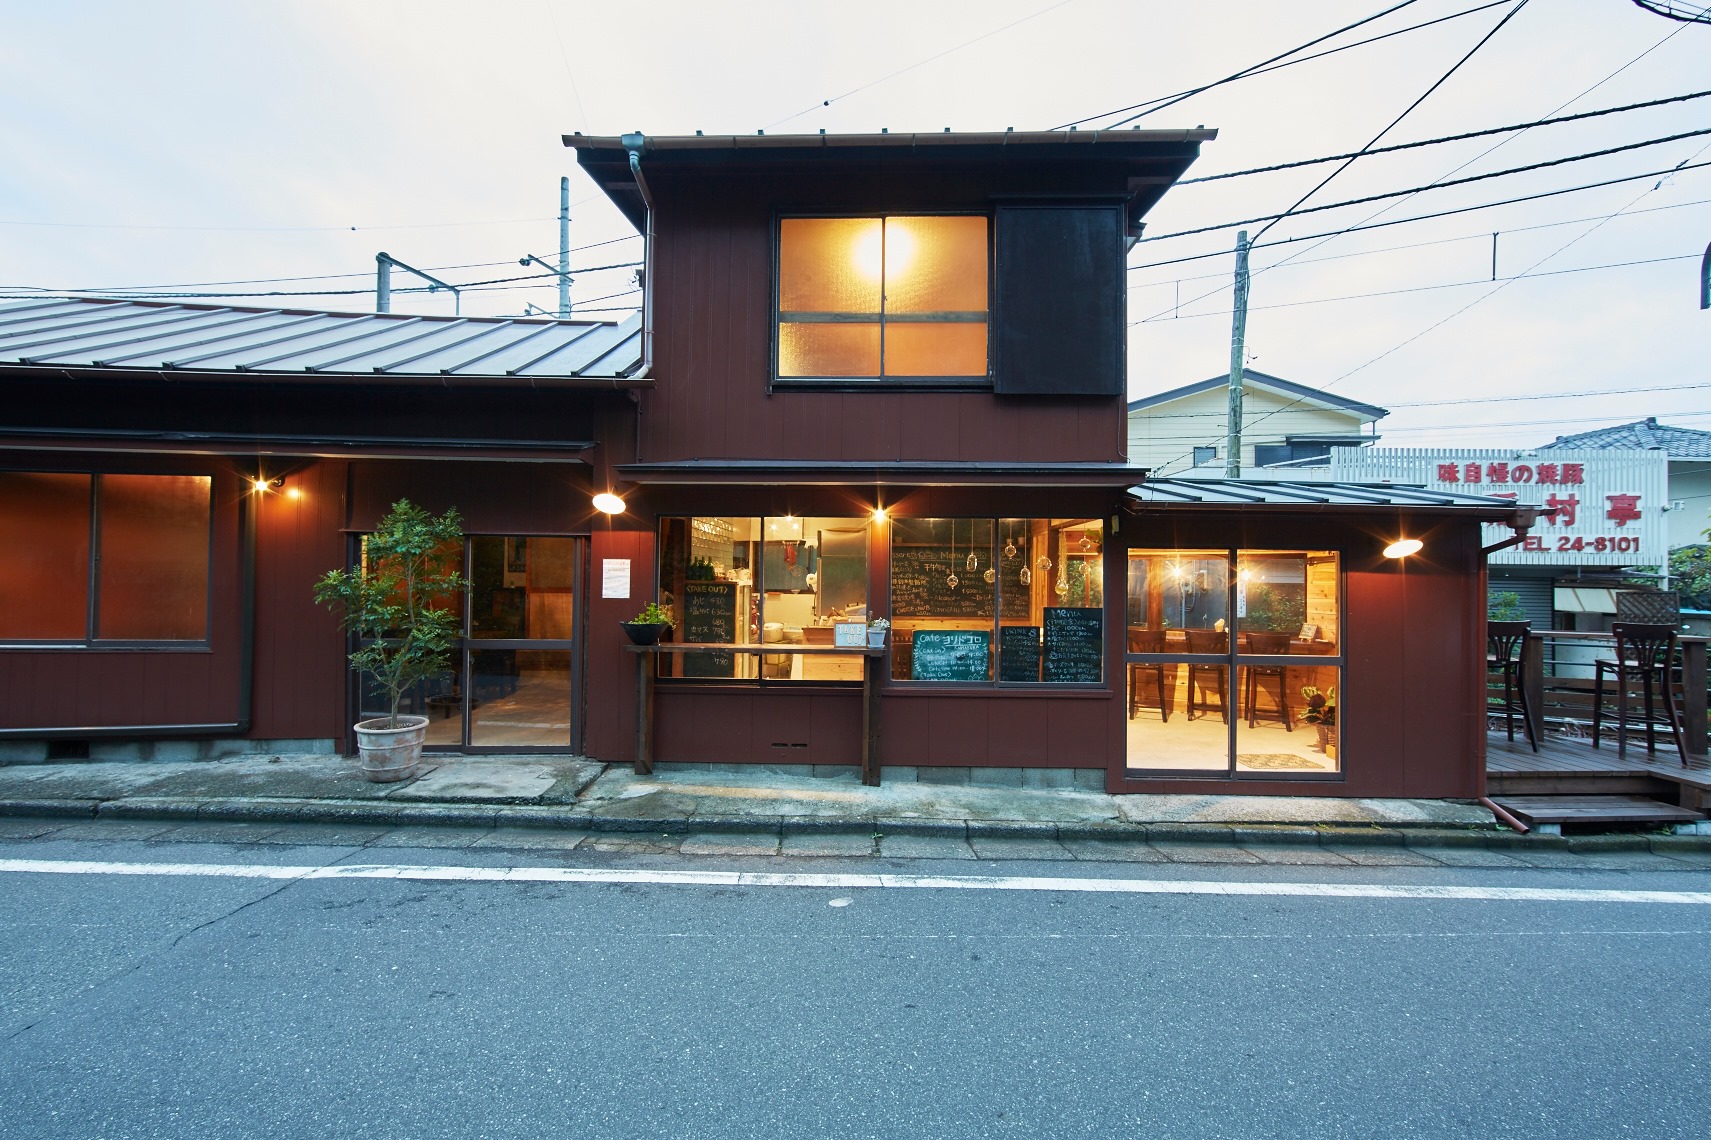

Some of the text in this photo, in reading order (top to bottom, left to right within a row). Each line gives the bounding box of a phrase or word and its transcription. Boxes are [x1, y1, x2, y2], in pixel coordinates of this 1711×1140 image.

[1437, 462, 1585, 485] 味自慢の焼豚
[1557, 534, 1640, 553] 24-8101
[1051, 609, 1081, 618] Menu
[838, 624, 862, 635] TAKE
[847, 634, 865, 645] OUT
